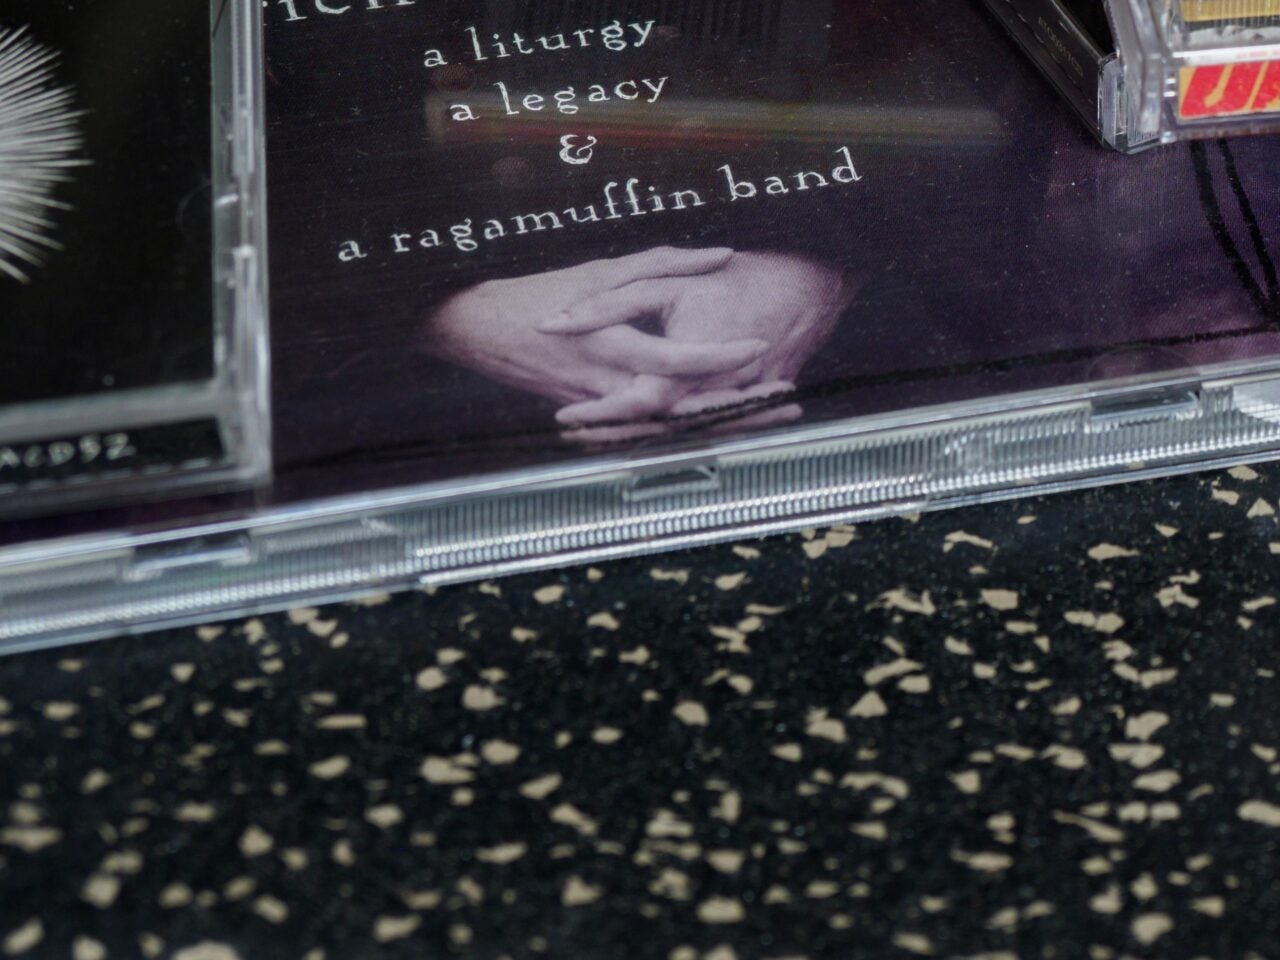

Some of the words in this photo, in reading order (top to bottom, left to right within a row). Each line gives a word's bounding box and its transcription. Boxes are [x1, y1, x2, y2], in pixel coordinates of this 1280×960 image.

[423, 48, 449, 68] a
[464, 18, 657, 63] liturgy
[449, 100, 481, 123] a
[494, 75, 670, 117] legacy
[558, 133, 598, 166] &
[337, 239, 368, 263] a
[390, 176, 705, 254] ragamuffin
[717, 145, 865, 202] band
